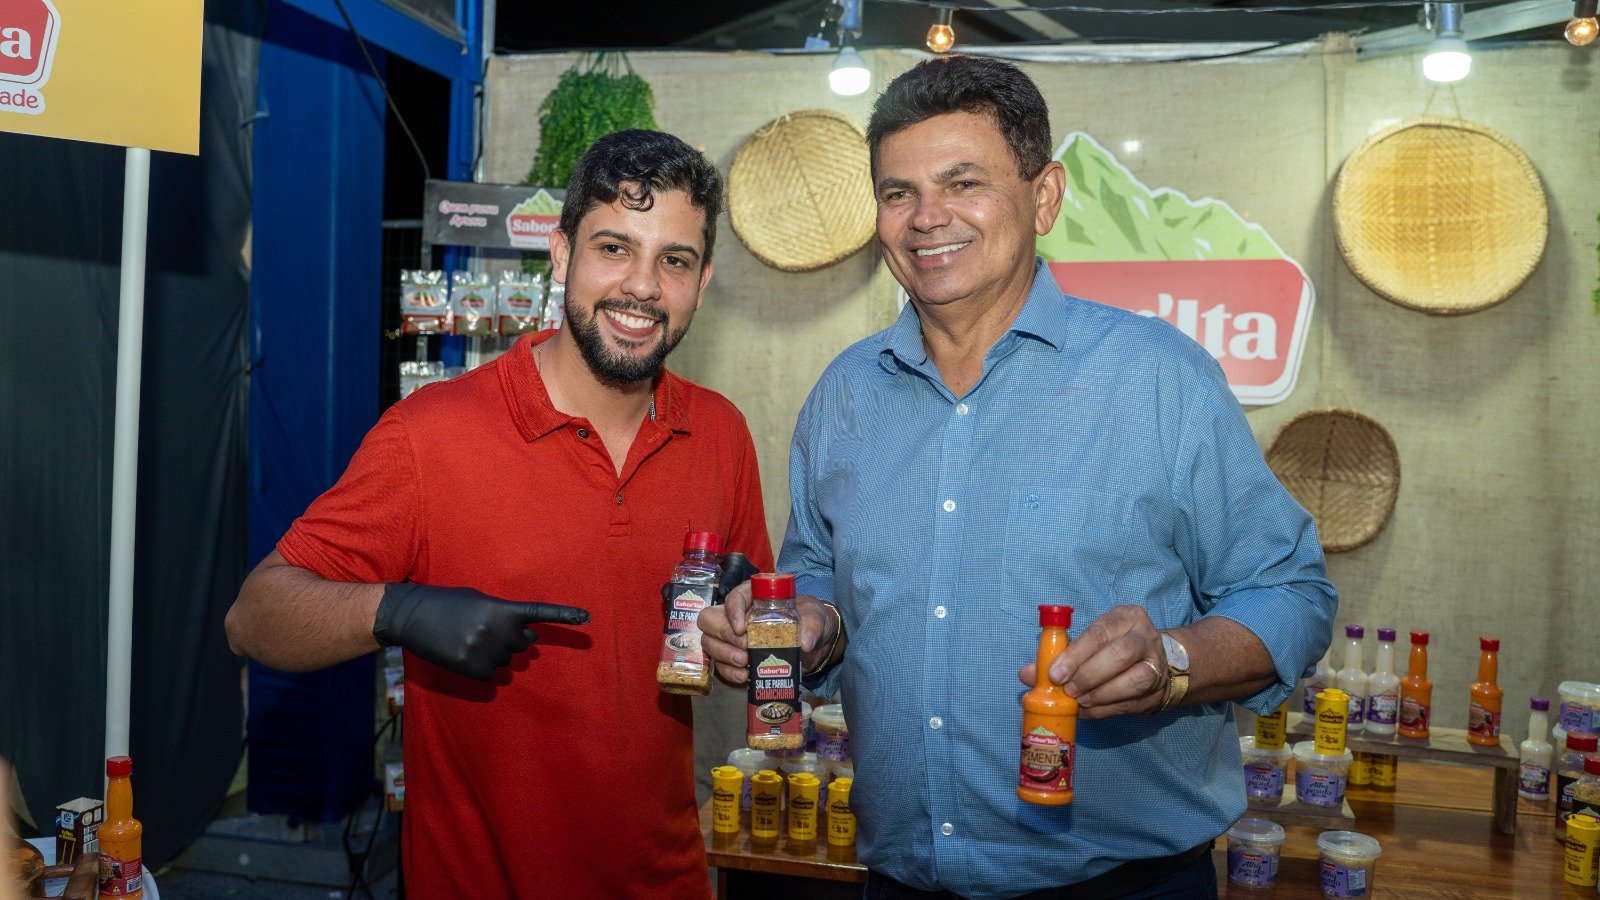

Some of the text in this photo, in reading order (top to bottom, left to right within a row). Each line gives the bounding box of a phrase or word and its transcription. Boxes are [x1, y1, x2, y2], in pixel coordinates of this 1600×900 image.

[0, 26, 32, 60] a
[669, 610, 678, 620] SAL
[755, 679, 794, 689] SAL DE PARRILLA
[755, 688, 795, 700] CHIMICHURRI
[1022, 750, 1062, 765] PIMENTA
